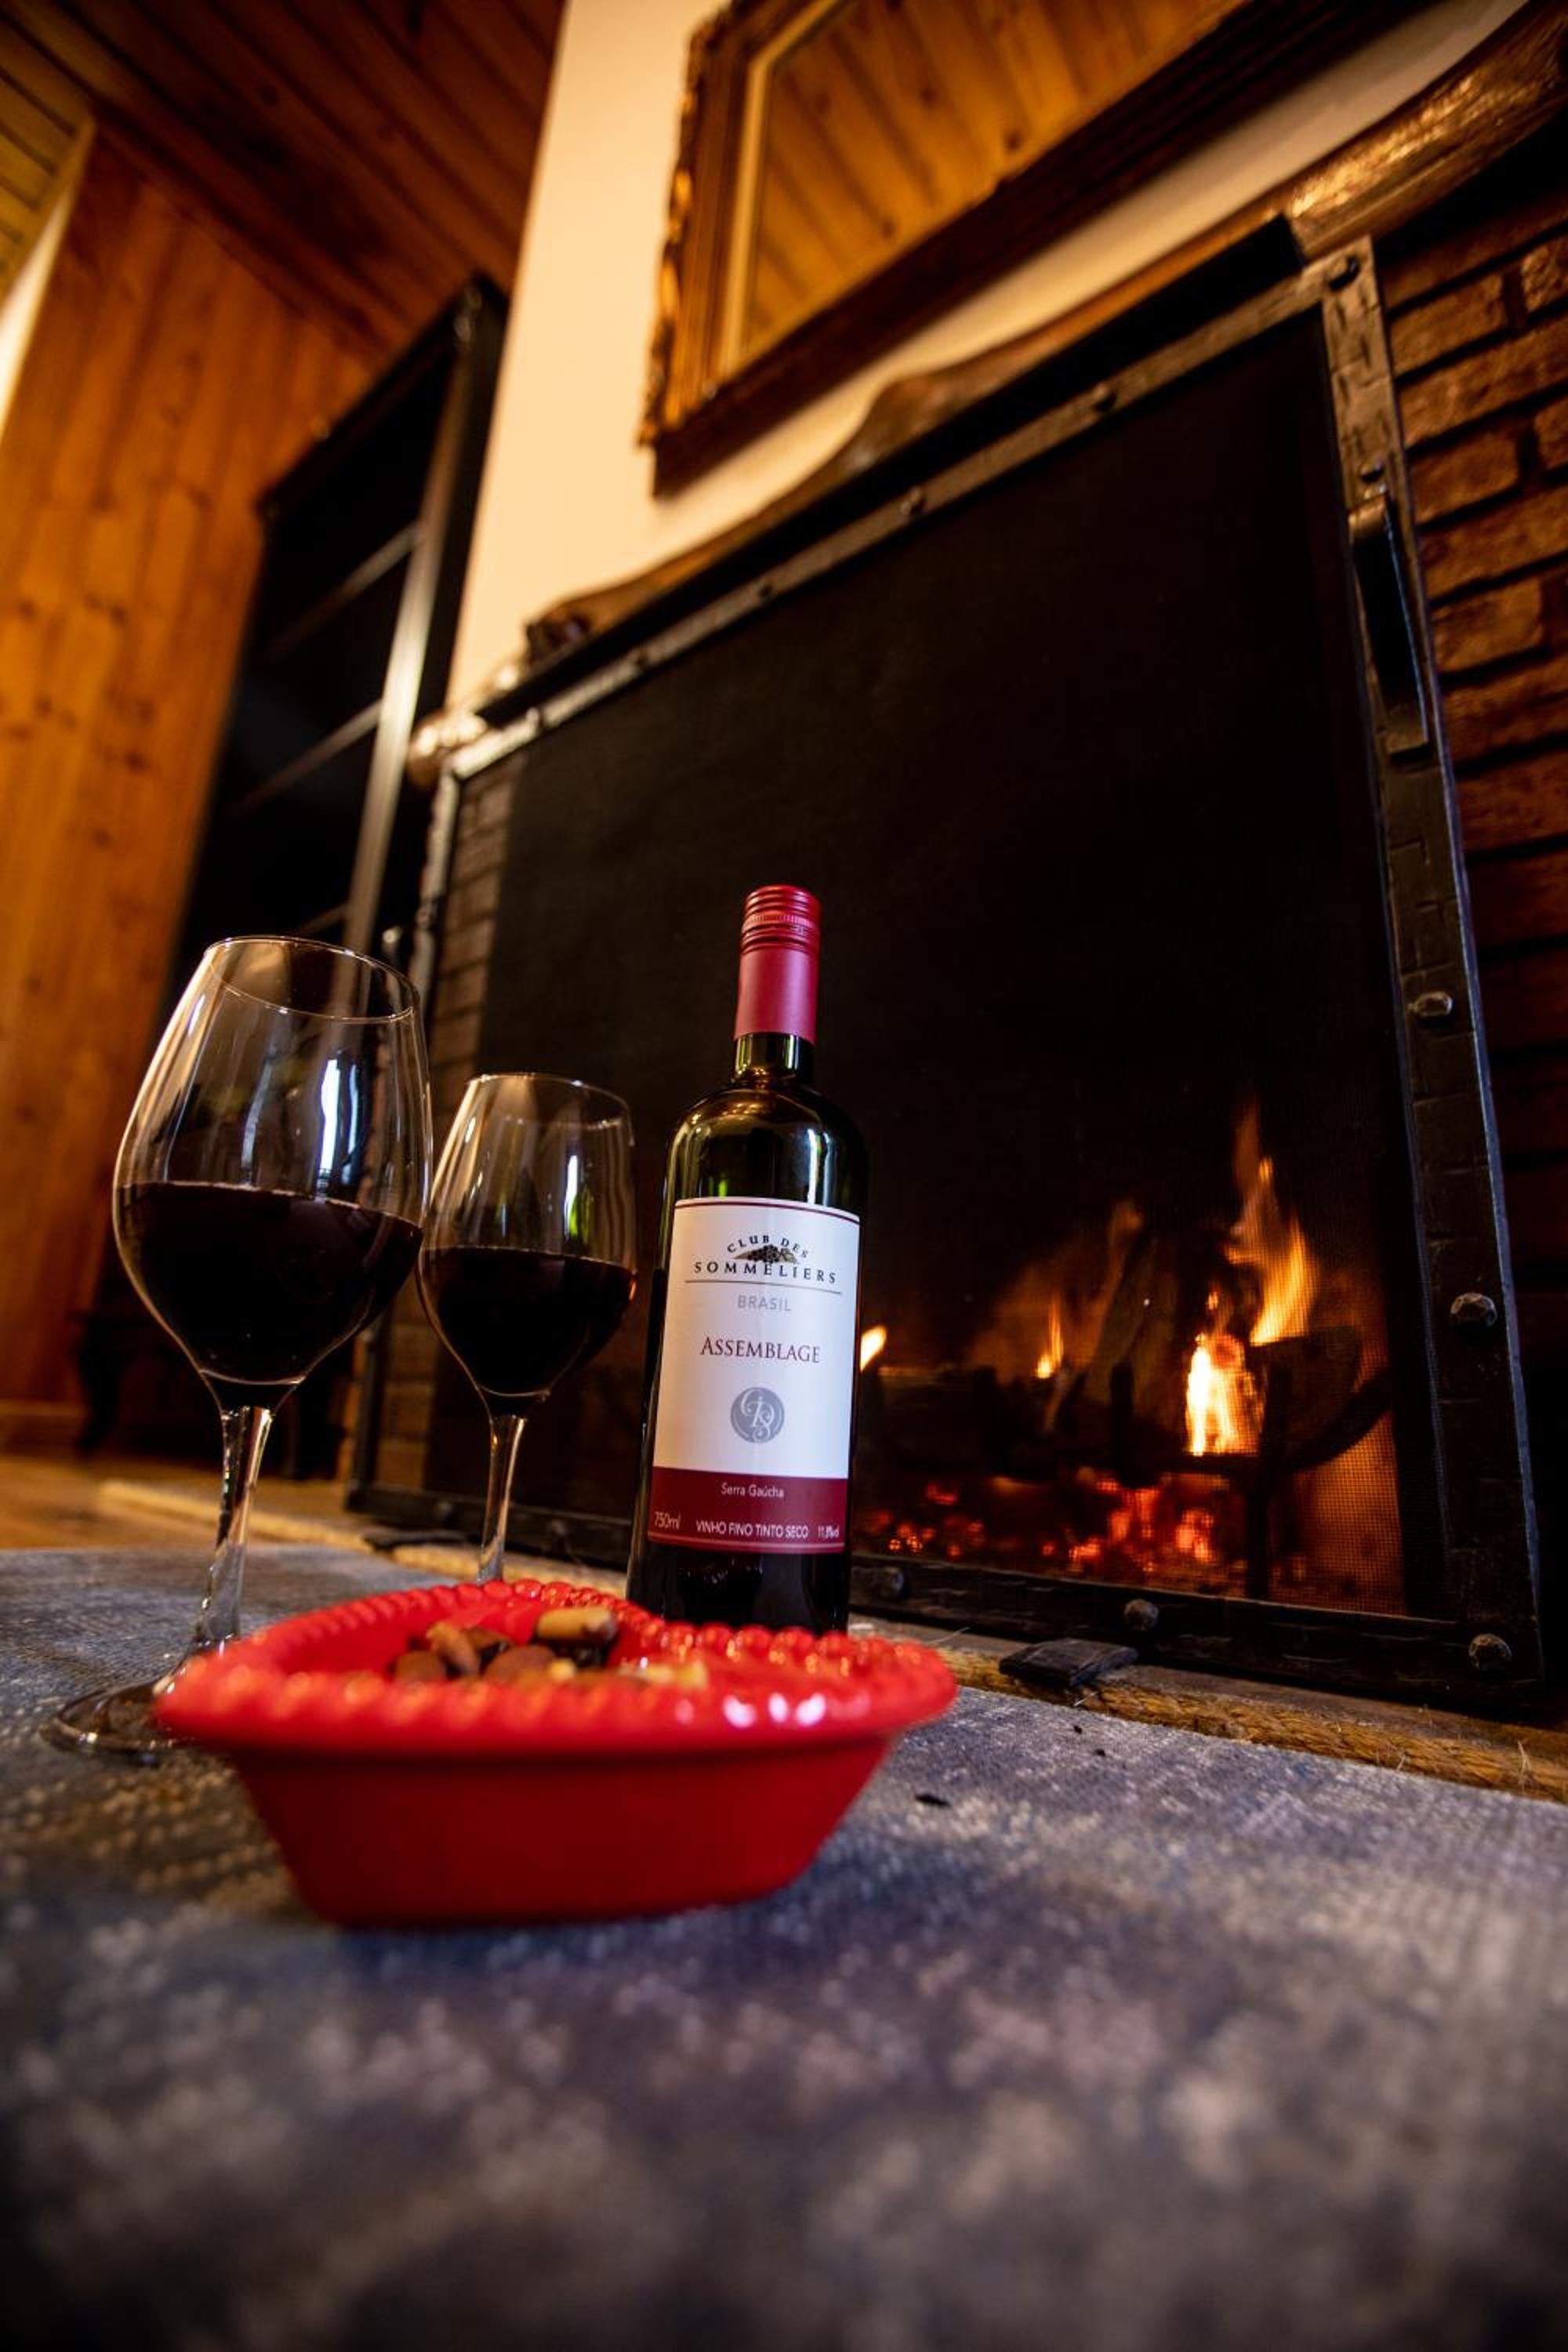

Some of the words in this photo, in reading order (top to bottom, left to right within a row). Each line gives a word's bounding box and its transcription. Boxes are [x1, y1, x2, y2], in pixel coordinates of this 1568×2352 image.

[727, 1235, 770, 1254] CLUB
[780, 1237, 808, 1258] DES
[694, 1261, 837, 1284] SOMMELIERS
[738, 1294, 791, 1312] BRASIL
[700, 1336, 820, 1363] ASSEMBLAGE
[720, 1482, 746, 1496] Serra
[748, 1483, 784, 1498] Gaúcha
[654, 1511, 681, 1530] 750ml
[695, 1519, 727, 1534] VINHO
[728, 1522, 753, 1537] FINO
[755, 1523, 784, 1537] TINTO
[784, 1525, 809, 1539] SECO
